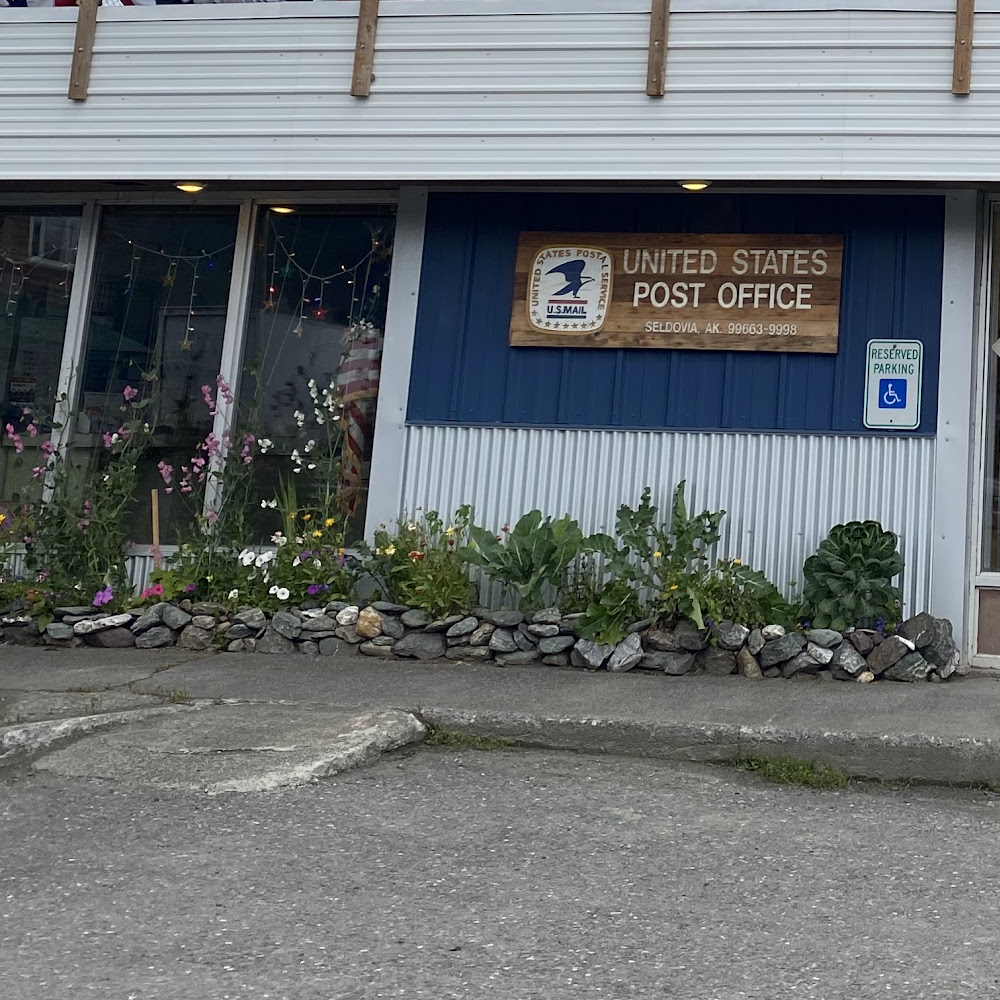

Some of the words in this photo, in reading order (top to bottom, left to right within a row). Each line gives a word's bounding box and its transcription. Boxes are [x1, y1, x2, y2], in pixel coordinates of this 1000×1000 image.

[623, 249, 718, 275] UNITED
[731, 249, 828, 276] STATES
[531, 268, 541, 307] UNITED
[536, 249, 571, 266] STATES
[576, 249, 609, 270] POSTAL
[597, 272, 609, 311] SERVICE
[632, 281, 706, 308] POST
[717, 282, 813, 310] OFFICE
[644, 321, 700, 334] SELDOVIA,
[727, 322, 798, 336] 99663-9998
[871, 348, 919, 360] RESERVED
[873, 363, 915, 375] PARKING
